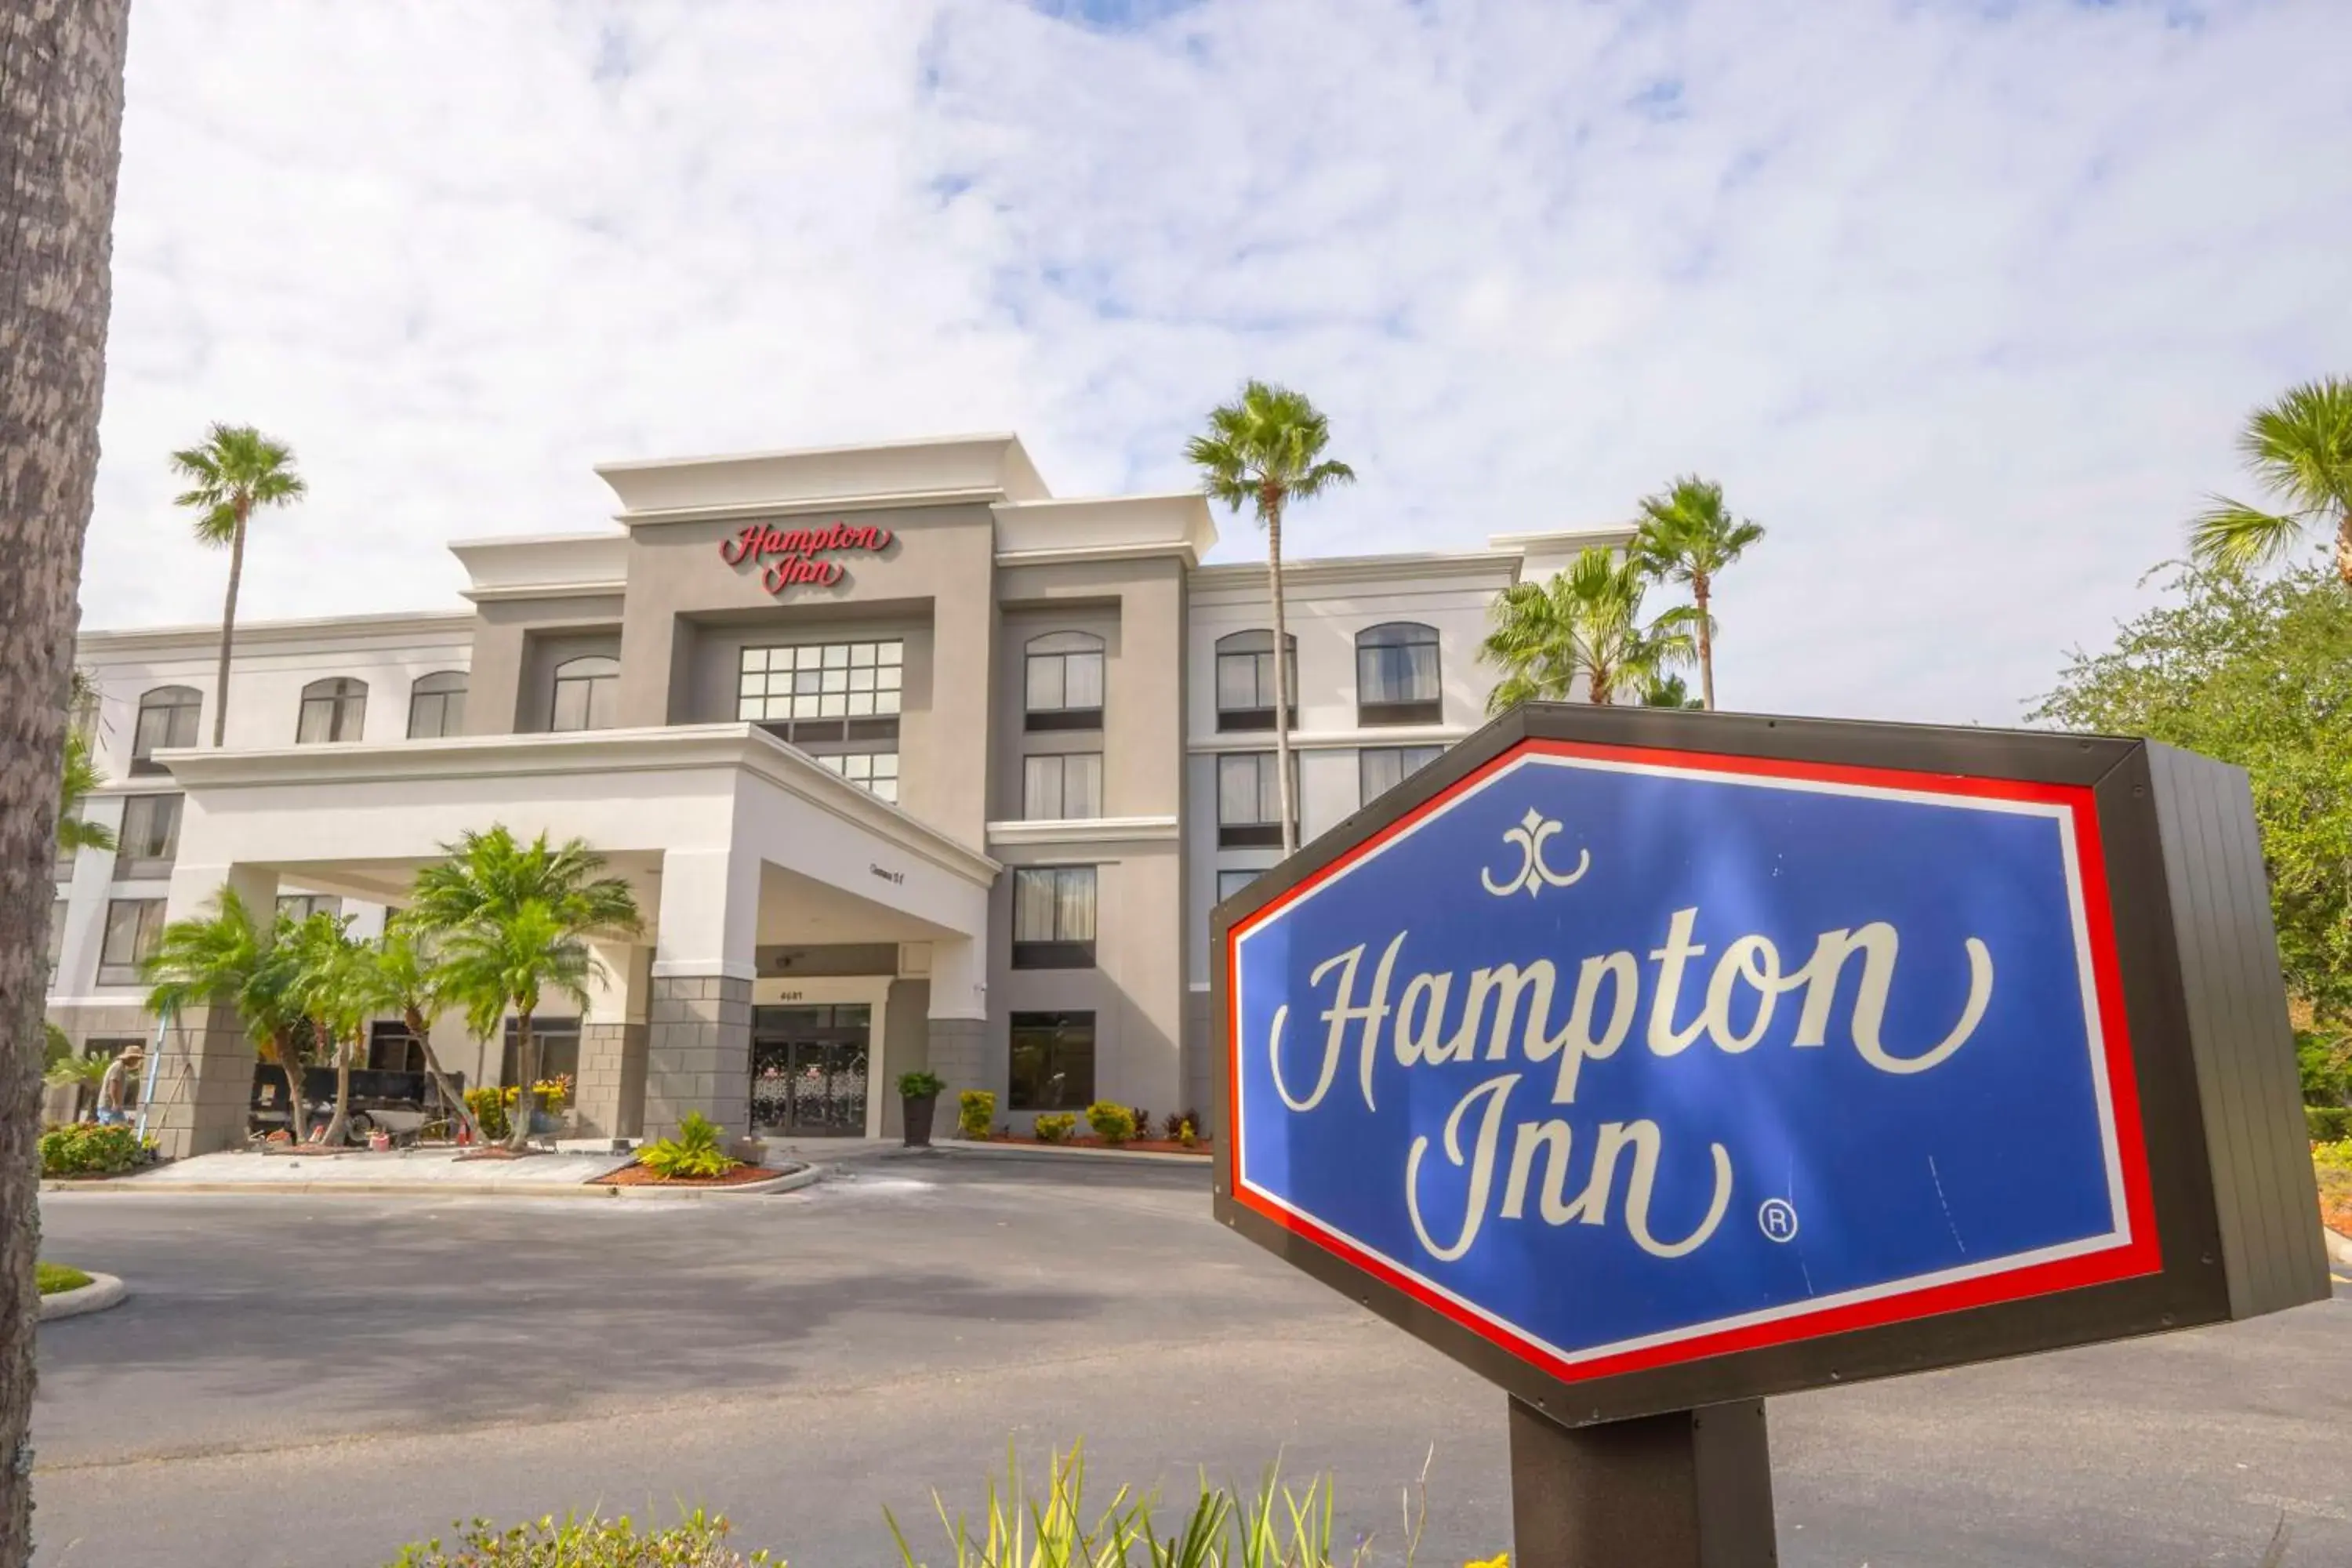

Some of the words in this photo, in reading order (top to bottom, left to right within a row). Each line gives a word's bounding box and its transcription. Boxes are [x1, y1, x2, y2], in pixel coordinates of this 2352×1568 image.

[720, 522, 891, 565] Hampton
[763, 555, 844, 594] Inn
[1269, 908, 1993, 1112] Hampton
[1406, 1073, 1732, 1261] Inn
